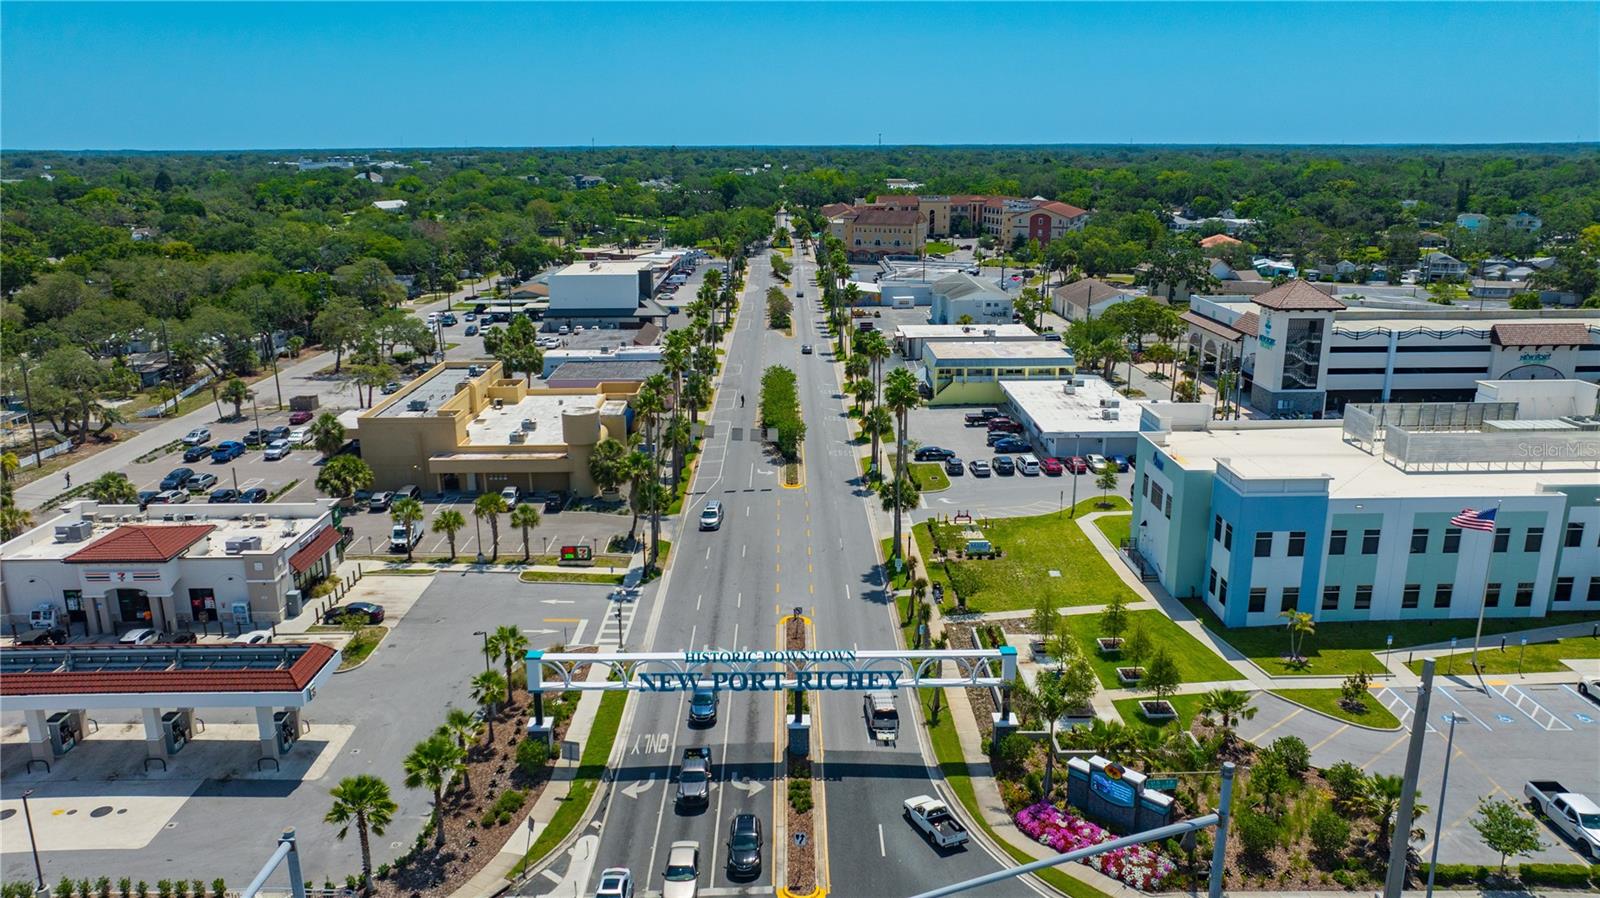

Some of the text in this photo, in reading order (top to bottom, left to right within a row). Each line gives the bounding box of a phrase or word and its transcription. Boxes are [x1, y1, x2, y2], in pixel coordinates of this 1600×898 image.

[685, 650, 856, 664] HISTORIC DOWNTOWN
[638, 671, 904, 692] NEW PORT RICHEY
[631, 733, 670, 755] ONLY
